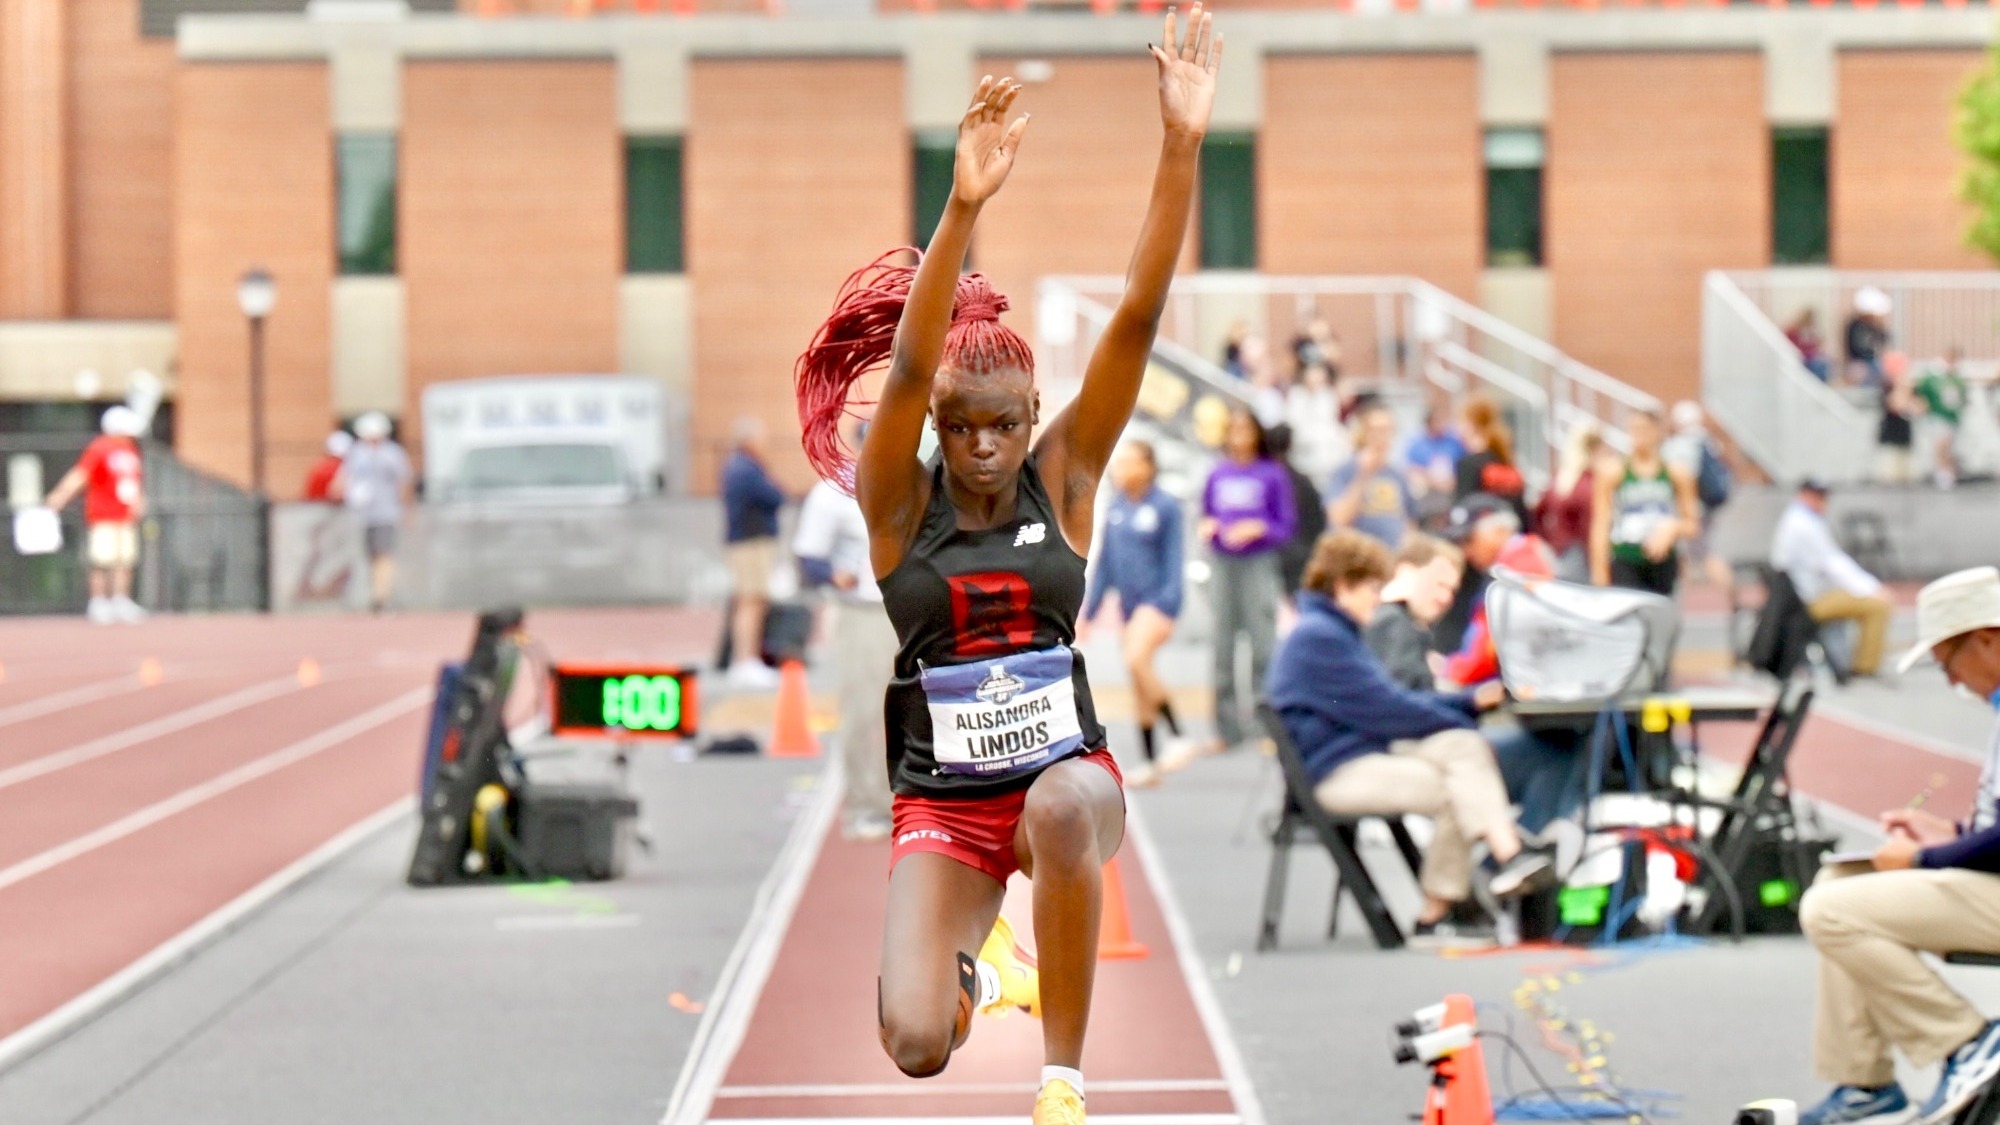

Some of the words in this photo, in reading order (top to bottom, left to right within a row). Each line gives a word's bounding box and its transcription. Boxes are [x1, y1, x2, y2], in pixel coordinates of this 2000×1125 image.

[603, 675, 680, 730] 1:00
[956, 695, 1052, 730] ALISANDRA
[966, 721, 1049, 759] LINDOS
[975, 763, 984, 771] LA
[898, 829, 952, 845] BATES
